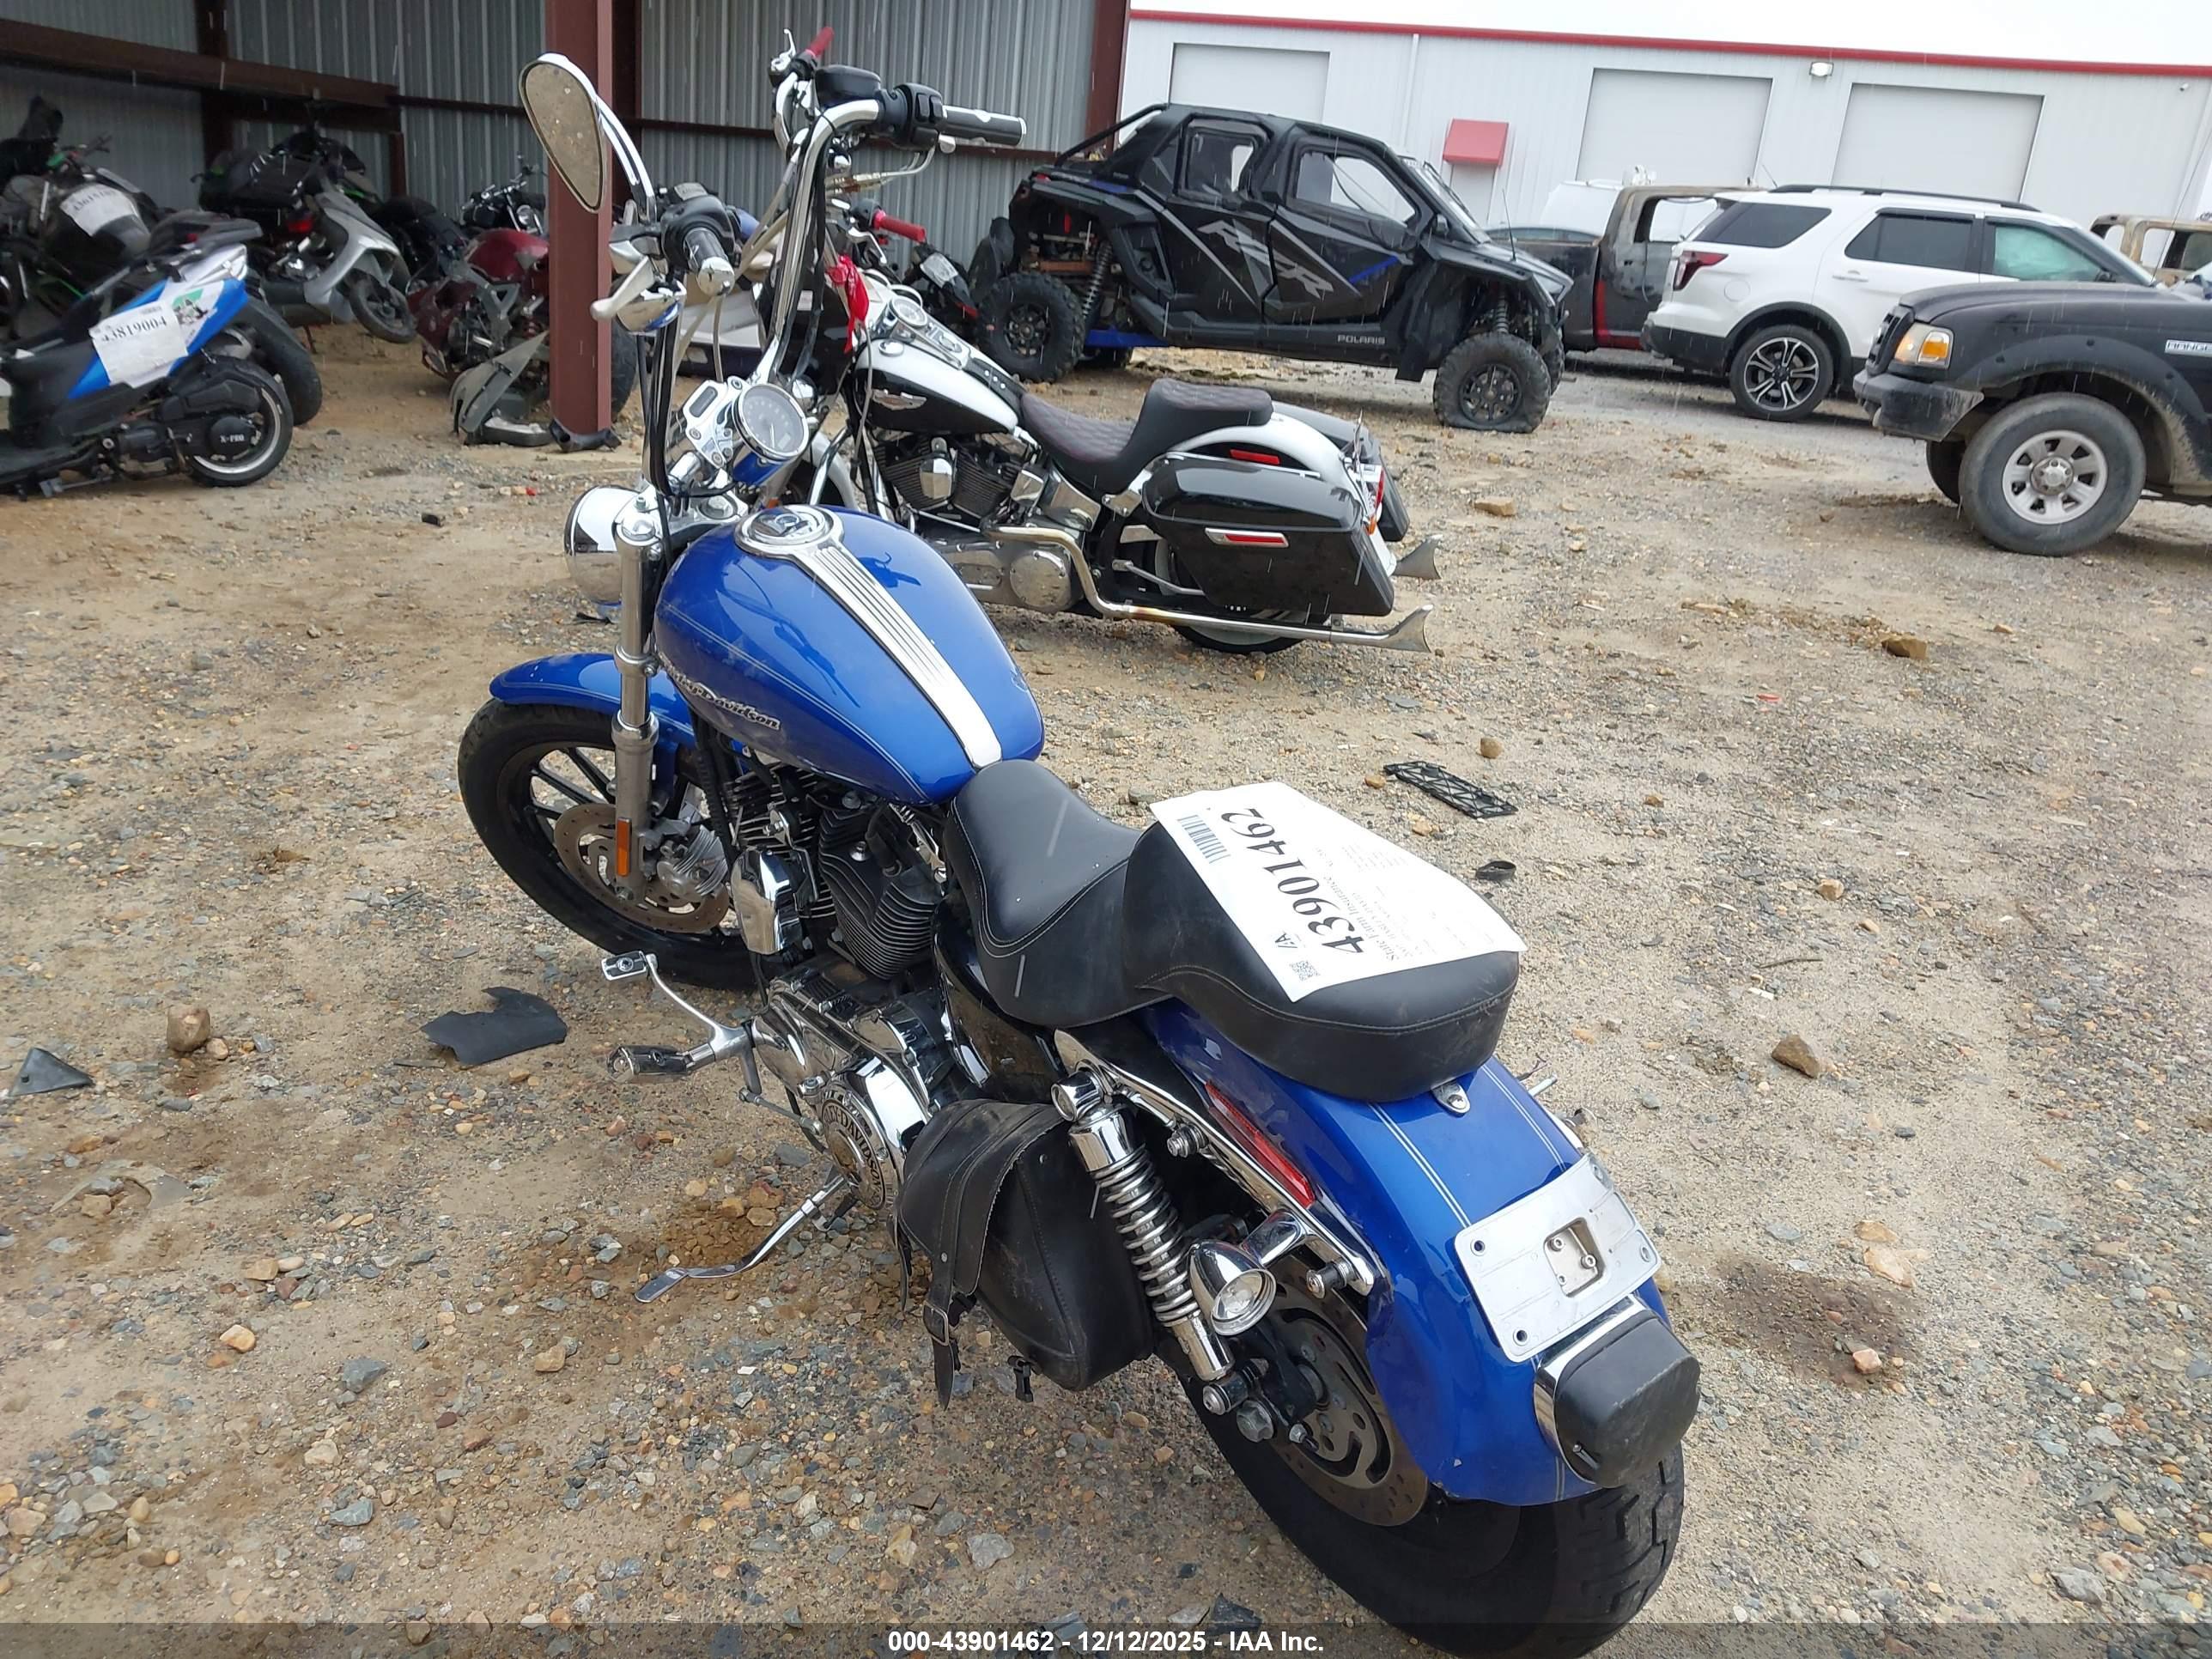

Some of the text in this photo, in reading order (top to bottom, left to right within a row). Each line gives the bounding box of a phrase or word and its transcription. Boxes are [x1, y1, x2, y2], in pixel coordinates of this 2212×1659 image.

[1337, 334, 1385, 344] POLARIS
[659, 652, 781, 730] ley-Davidson
[1221, 808, 1364, 954] 43901462
